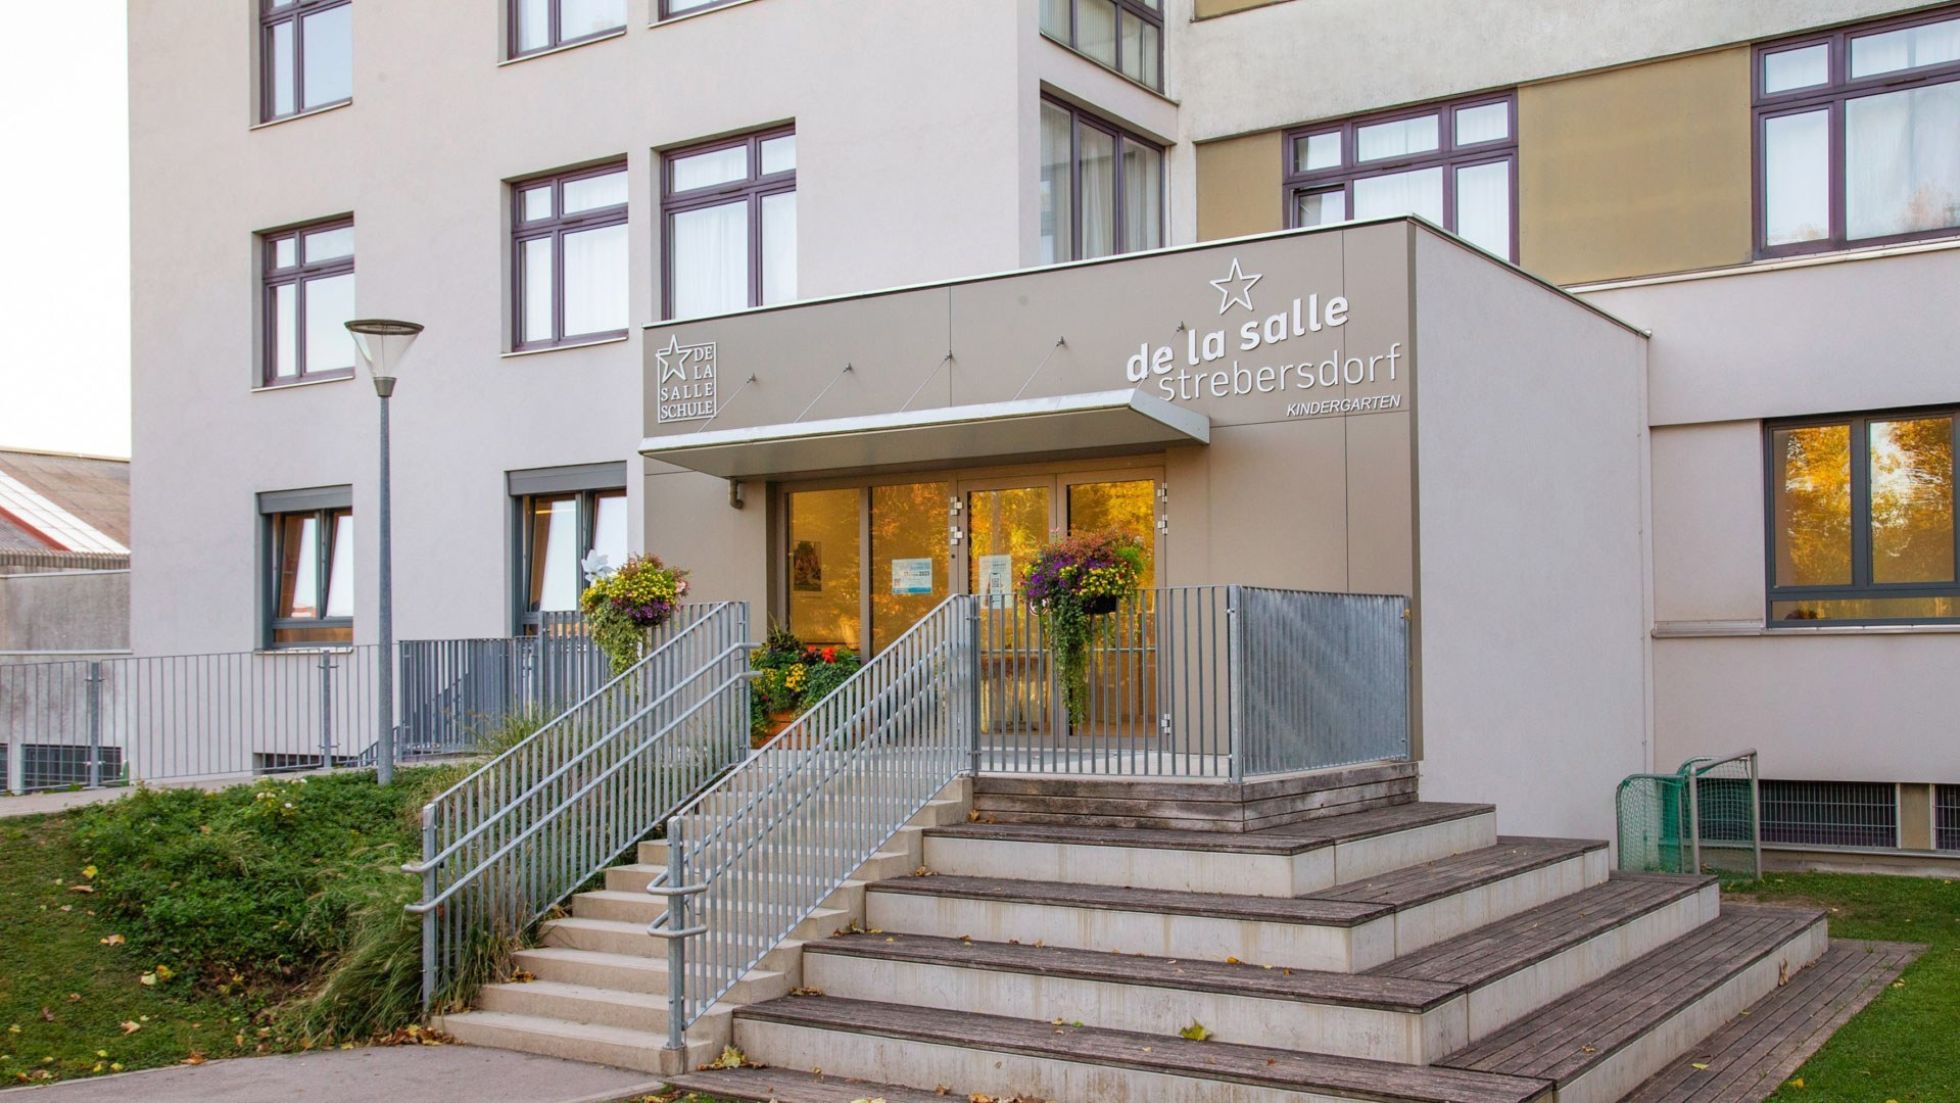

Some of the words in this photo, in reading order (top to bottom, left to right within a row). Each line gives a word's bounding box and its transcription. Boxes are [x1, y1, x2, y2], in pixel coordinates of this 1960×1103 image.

[1127, 342, 1174, 382] de
[1188, 329, 1225, 365] la
[1240, 293, 1349, 351] salle
[694, 346, 713, 362] DE
[694, 364, 713, 380] LA
[1159, 343, 1401, 402] strebersdorf
[661, 382, 713, 401] SALLE
[661, 401, 713, 419] SCHULE
[1287, 394, 1401, 417] KINDERGARTEN
